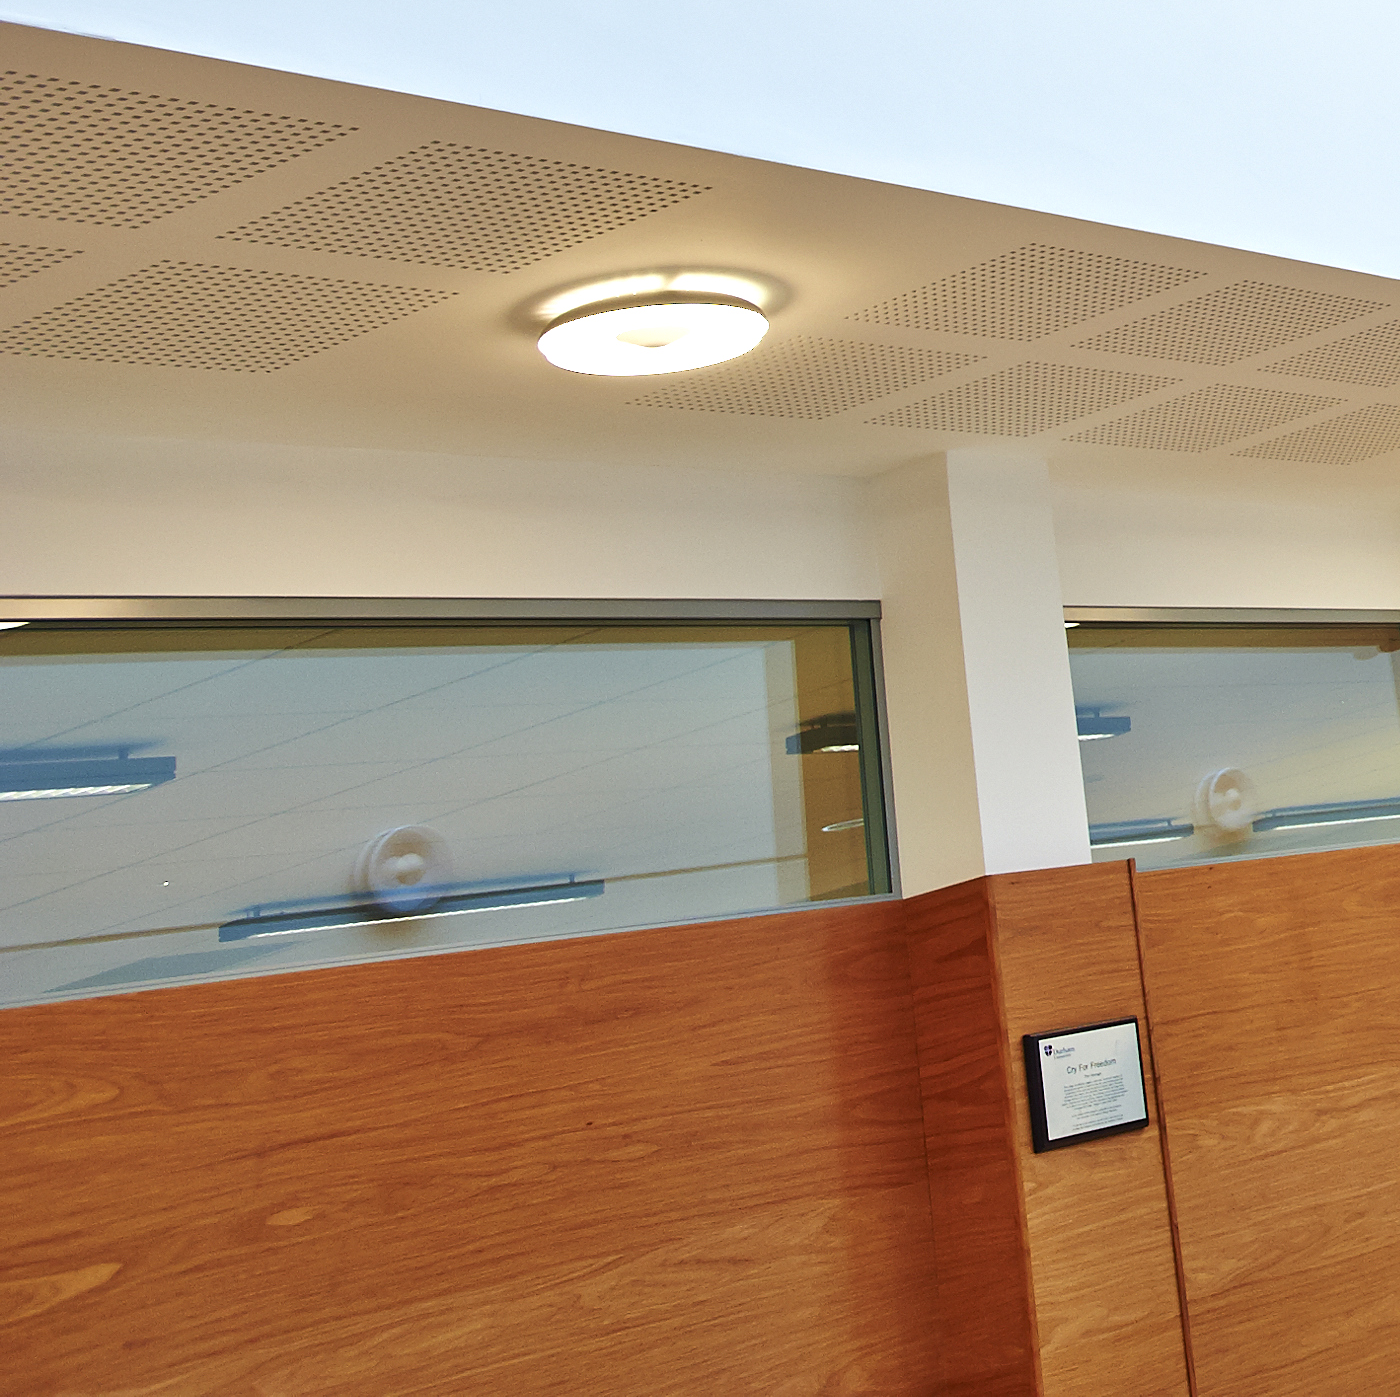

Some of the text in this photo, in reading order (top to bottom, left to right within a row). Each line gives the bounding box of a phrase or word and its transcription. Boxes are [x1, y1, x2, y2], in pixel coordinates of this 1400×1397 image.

[1066, 1059, 1116, 1074] Cry For Freedom
